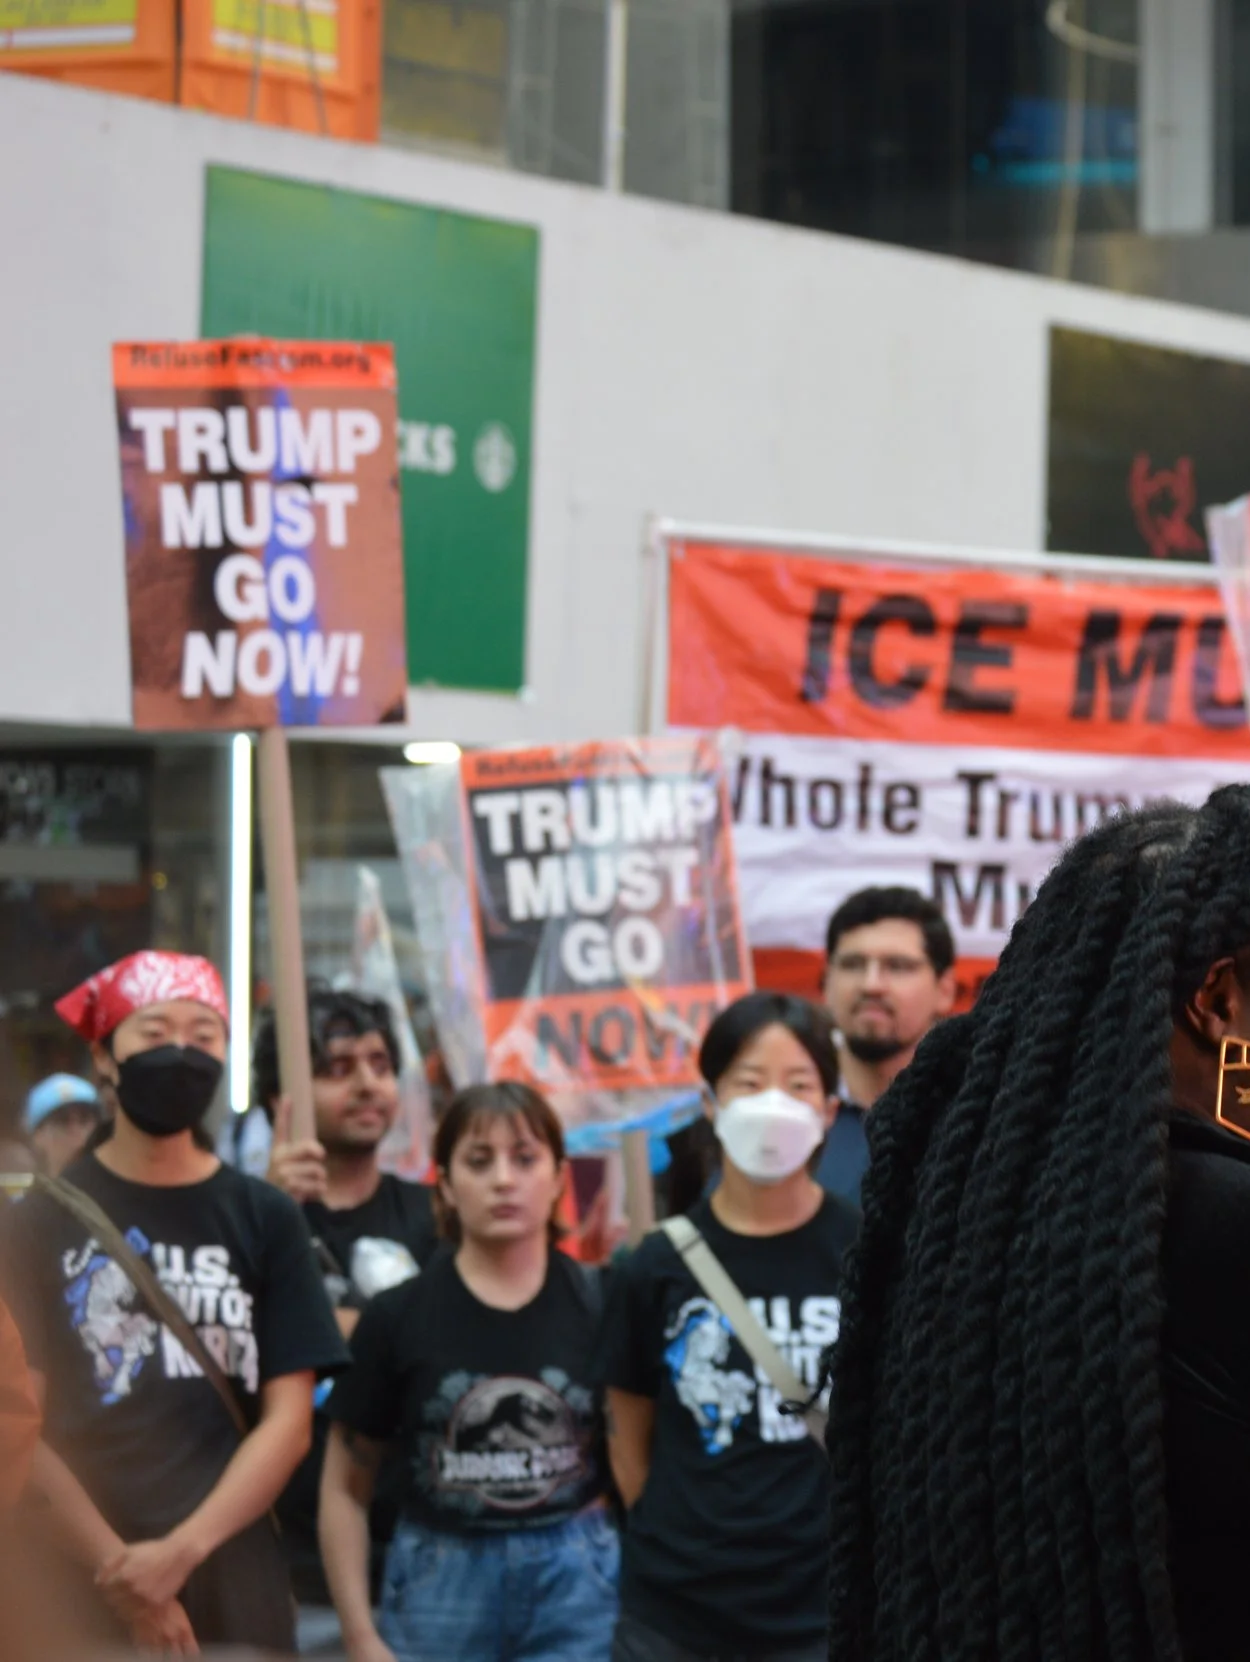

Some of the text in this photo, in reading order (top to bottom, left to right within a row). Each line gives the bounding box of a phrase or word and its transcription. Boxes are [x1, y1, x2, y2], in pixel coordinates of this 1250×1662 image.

[128, 405, 382, 475] TRUMP
[160, 483, 358, 548] MUST
[213, 554, 317, 623] GO
[181, 631, 364, 698] NOW!
[797, 586, 1031, 714] ICE
[473, 784, 716, 856] TRUMP
[506, 848, 699, 922] MUST
[561, 917, 664, 985] GO
[152, 1242, 241, 1288] U.S.
